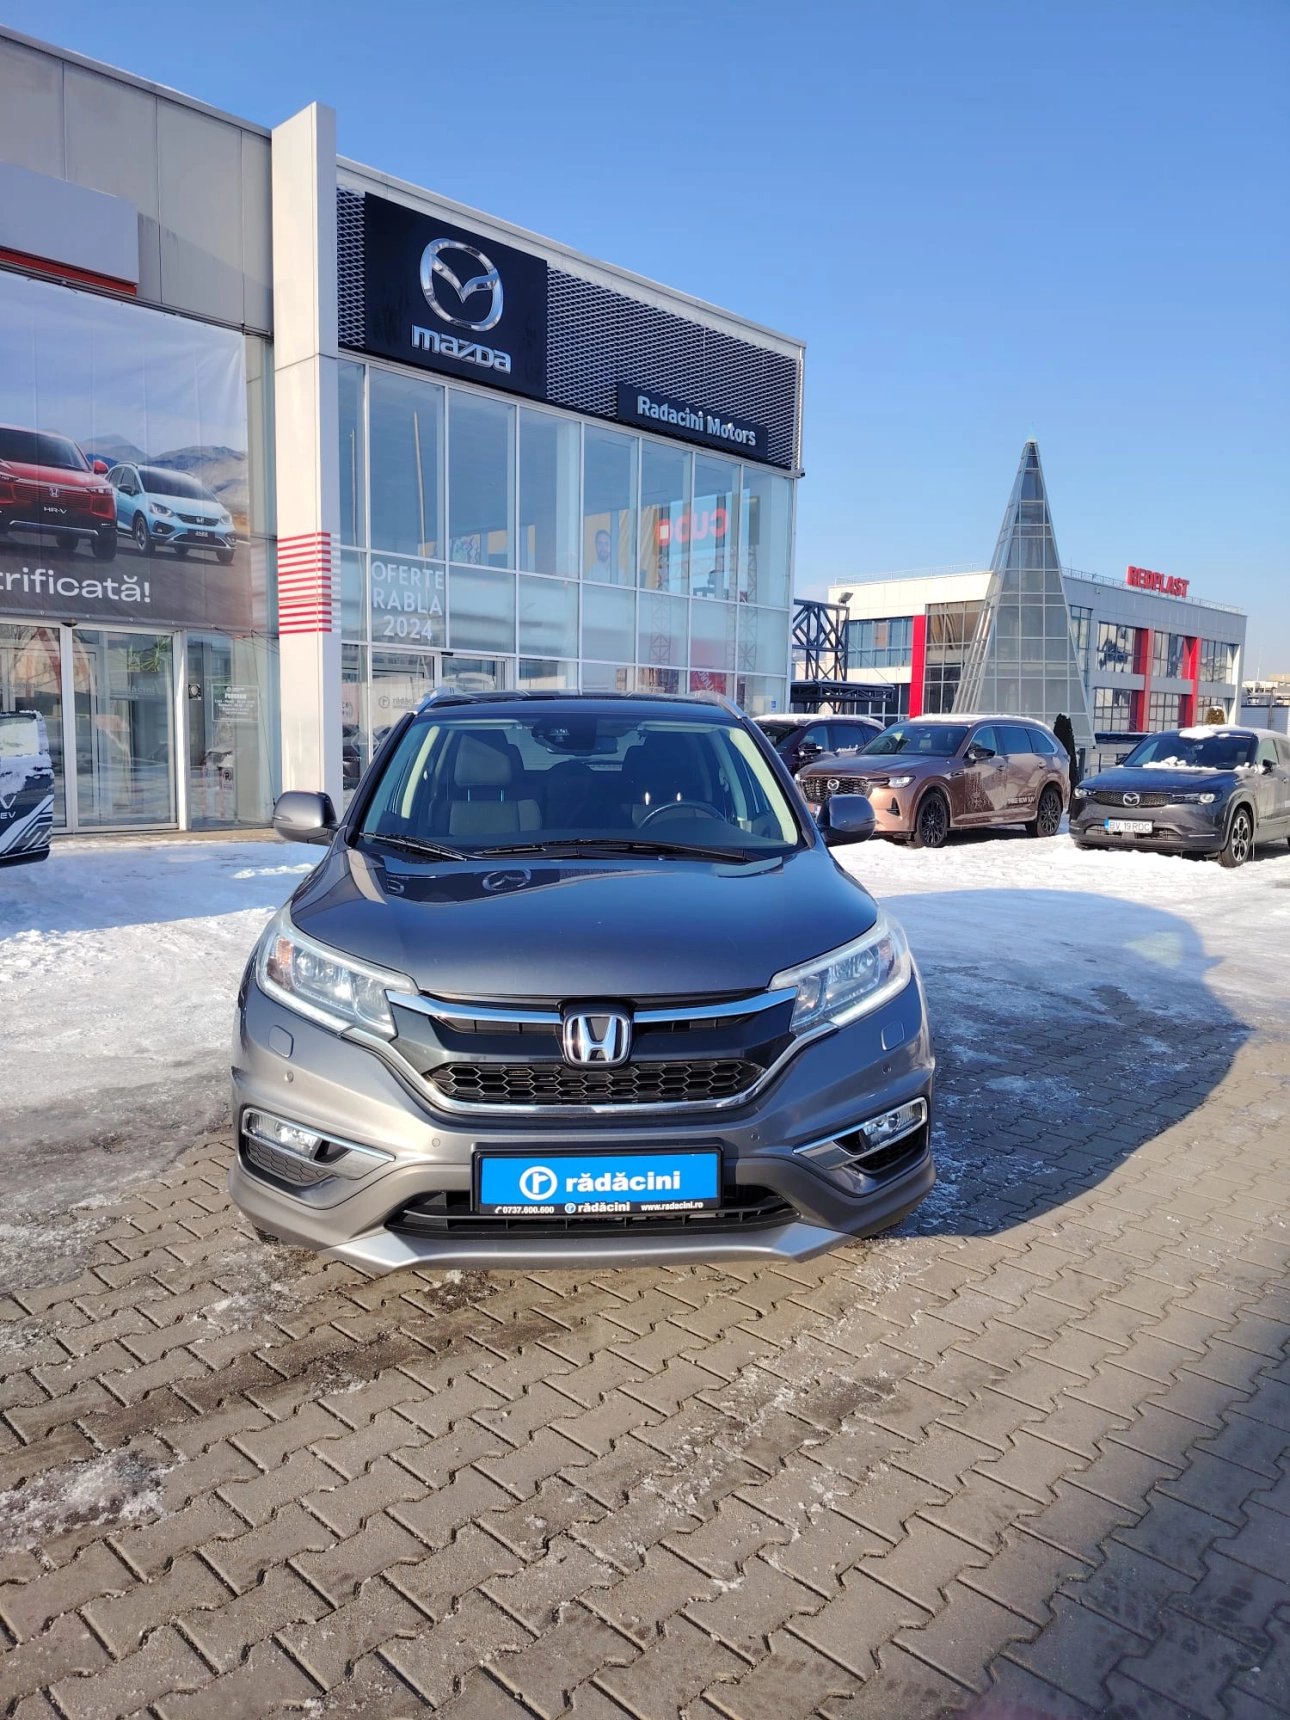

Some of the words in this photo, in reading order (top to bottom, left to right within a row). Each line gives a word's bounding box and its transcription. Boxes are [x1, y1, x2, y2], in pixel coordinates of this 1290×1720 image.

[412, 324, 512, 375] mazda
[637, 396, 704, 431] Radacini
[707, 415, 756, 446] Motors
[44, 506, 67, 515] HR-V
[0, 567, 151, 602] rificată!
[371, 561, 444, 590] OFERTE
[1127, 566, 1189, 598] REDPLAST
[373, 587, 443, 616] RABLA
[383, 614, 433, 640] 2024
[565, 1170, 681, 1193] rădăcini
[502, 1205, 555, 1215] 0737.600.600
[577, 1201, 631, 1214] rădăcini
[640, 1201, 704, 1212] www.radacini.ro
